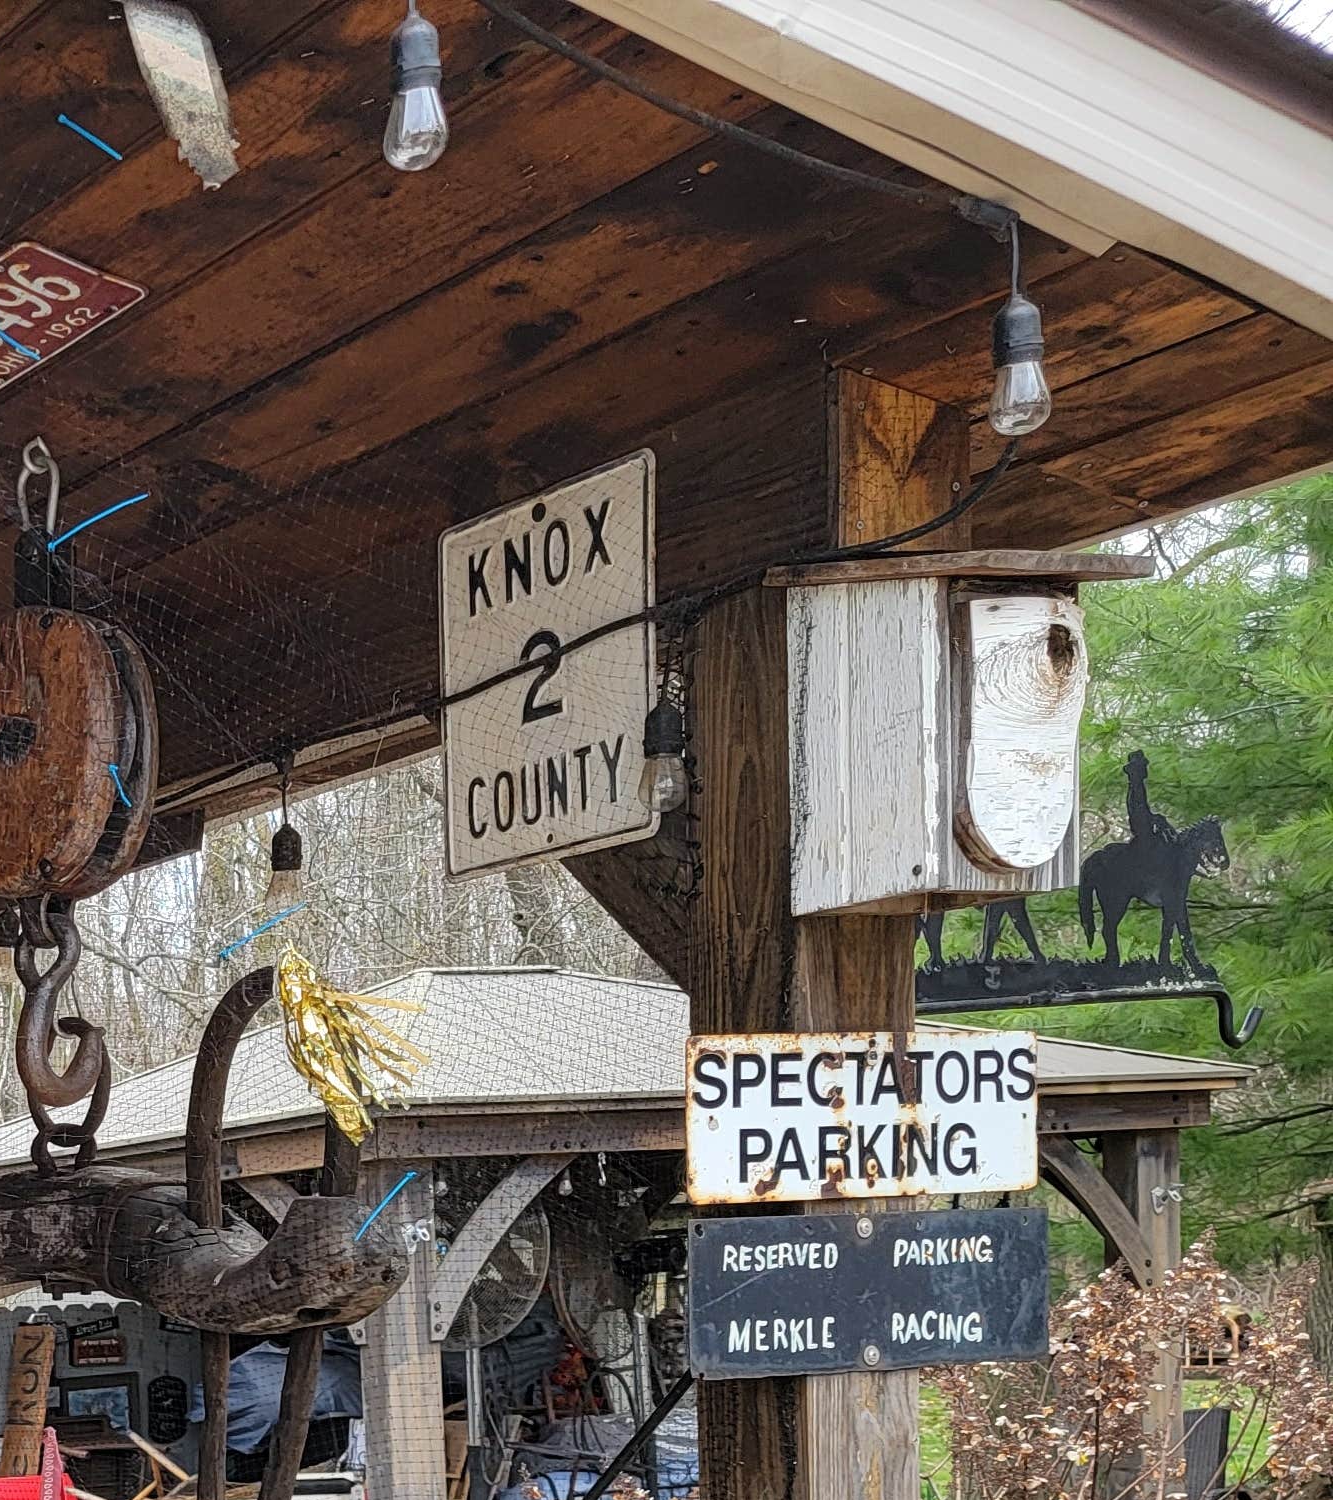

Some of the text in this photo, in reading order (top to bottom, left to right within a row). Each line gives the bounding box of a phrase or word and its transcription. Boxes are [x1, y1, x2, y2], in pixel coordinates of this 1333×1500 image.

[45, 306, 101, 339] 1962
[468, 499, 613, 618] KNOX
[519, 627, 565, 726] 2
[467, 734, 626, 840] COUNTY
[691, 1046, 1038, 1110] SPECTATORS
[738, 1122, 978, 1184] PARKING
[721, 1234, 995, 1273] RESERVED PARKING
[727, 1310, 984, 1354] MERKLE RACING
